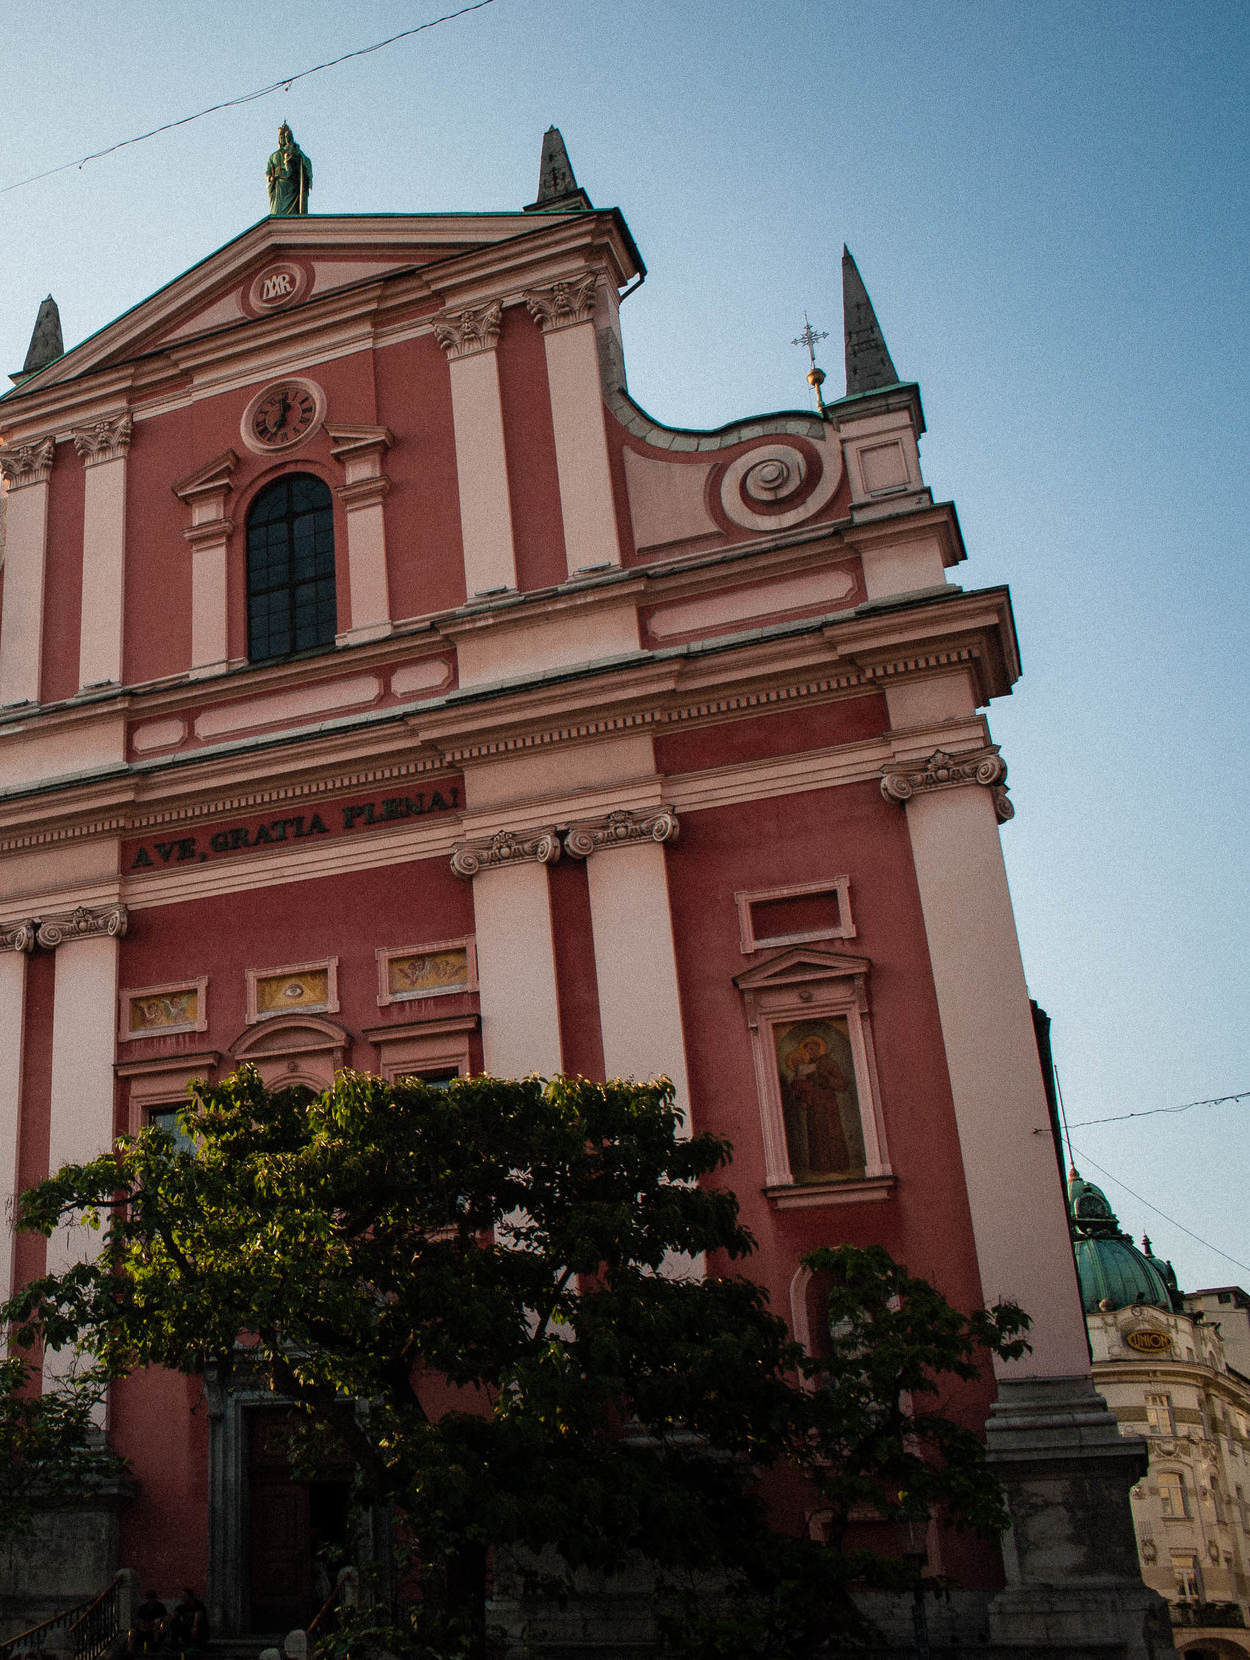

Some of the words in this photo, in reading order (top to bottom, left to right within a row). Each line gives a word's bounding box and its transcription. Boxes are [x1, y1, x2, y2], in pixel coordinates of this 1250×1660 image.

[131, 838, 206, 868] AVE,
[210, 813, 329, 853] GRATIA
[342, 787, 458, 828] PLENA!
[1133, 1334, 1168, 1347] UNION
